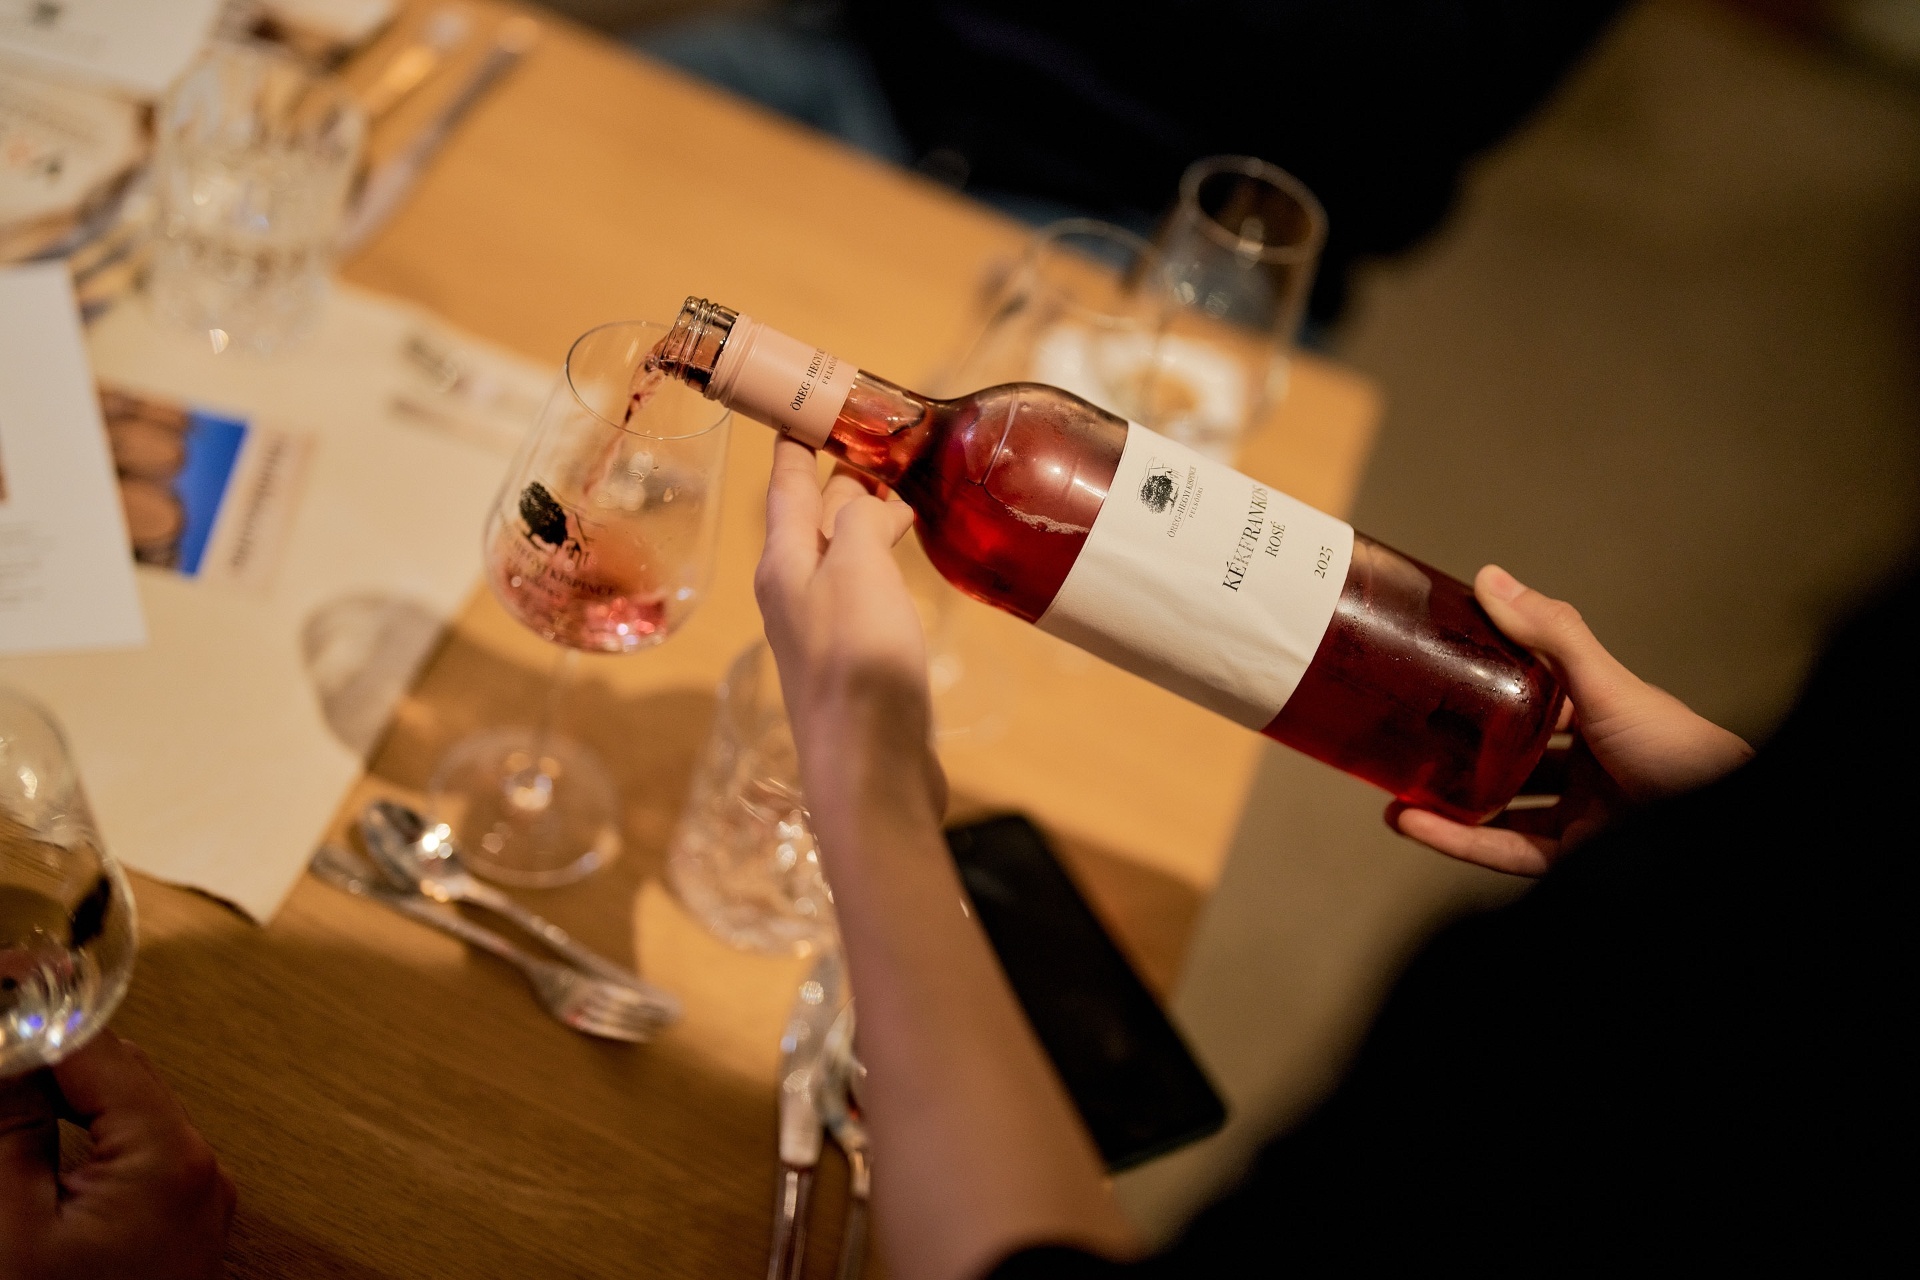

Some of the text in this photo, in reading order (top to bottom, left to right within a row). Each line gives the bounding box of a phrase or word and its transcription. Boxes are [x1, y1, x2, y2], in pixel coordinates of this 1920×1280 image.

[1221, 484, 1269, 593] KÉKFRANKOS
[1264, 520, 1286, 558] ROSÉ
[1313, 545, 1335, 580] 2025
